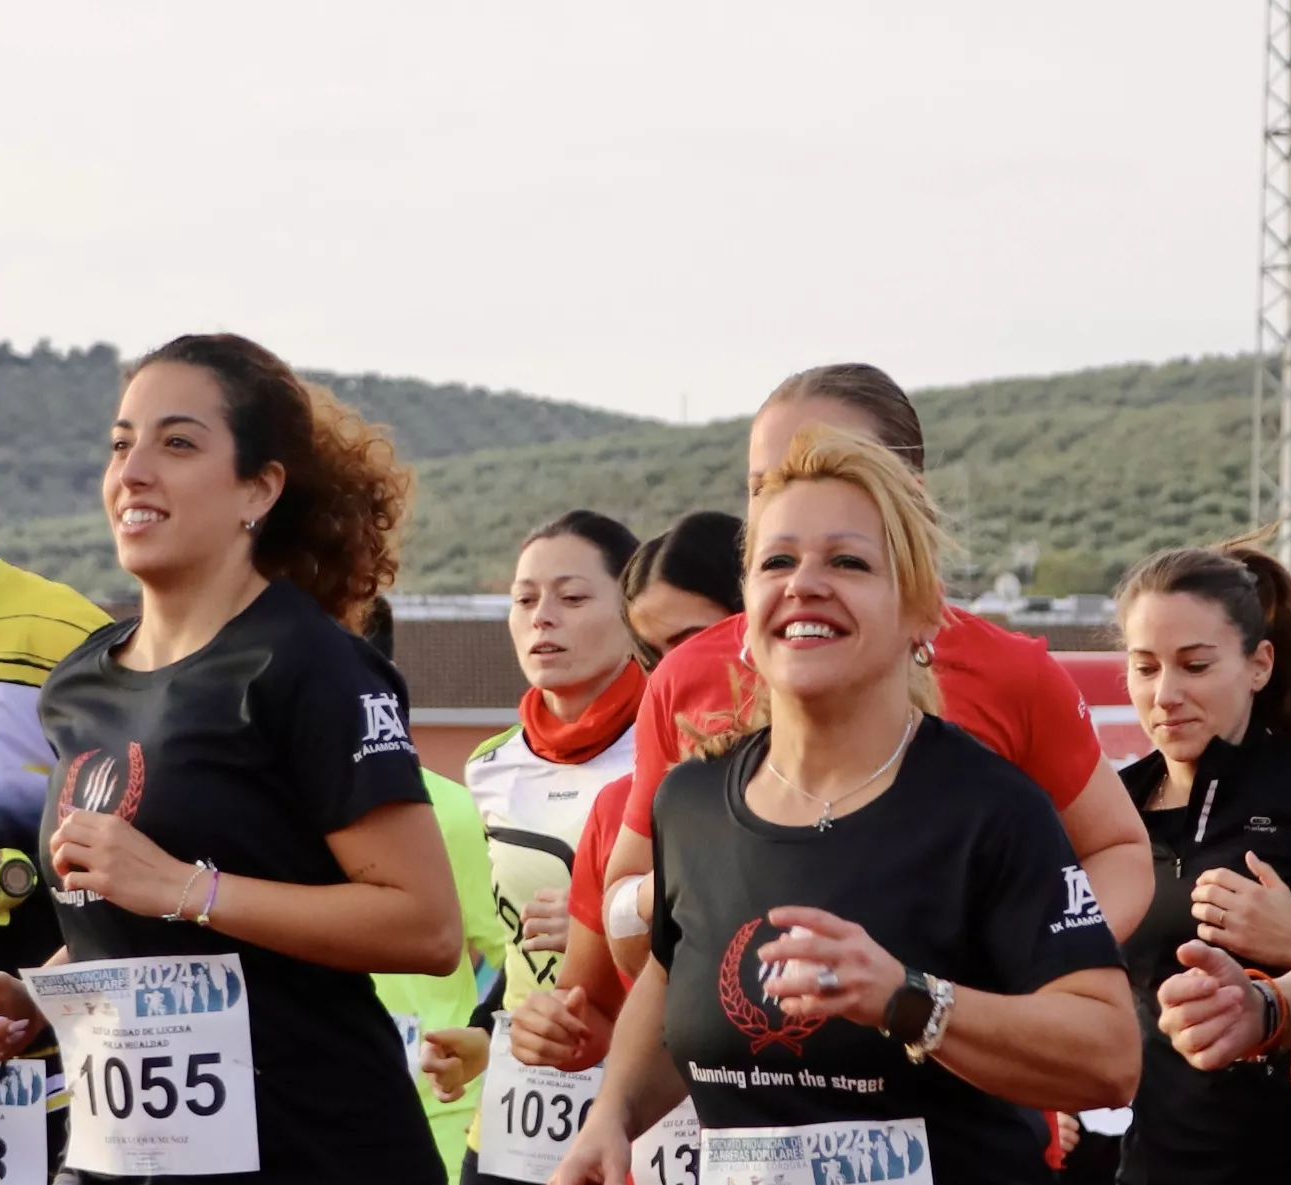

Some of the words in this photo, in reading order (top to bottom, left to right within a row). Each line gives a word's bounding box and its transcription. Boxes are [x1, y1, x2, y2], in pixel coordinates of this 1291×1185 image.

[1065, 914, 1105, 929] ÁLAMO
[133, 962, 195, 990] 2024
[142, 1025, 154, 1036] DE
[157, 1023, 193, 1035] LUCENA
[80, 1052, 227, 1120] 1055
[688, 1060, 747, 1089] Running
[750, 1065, 795, 1087] down
[798, 1068, 827, 1088] the
[830, 1074, 886, 1094] street
[750, 1147, 805, 1161] POPULARES
[805, 1130, 873, 1160] 2024
